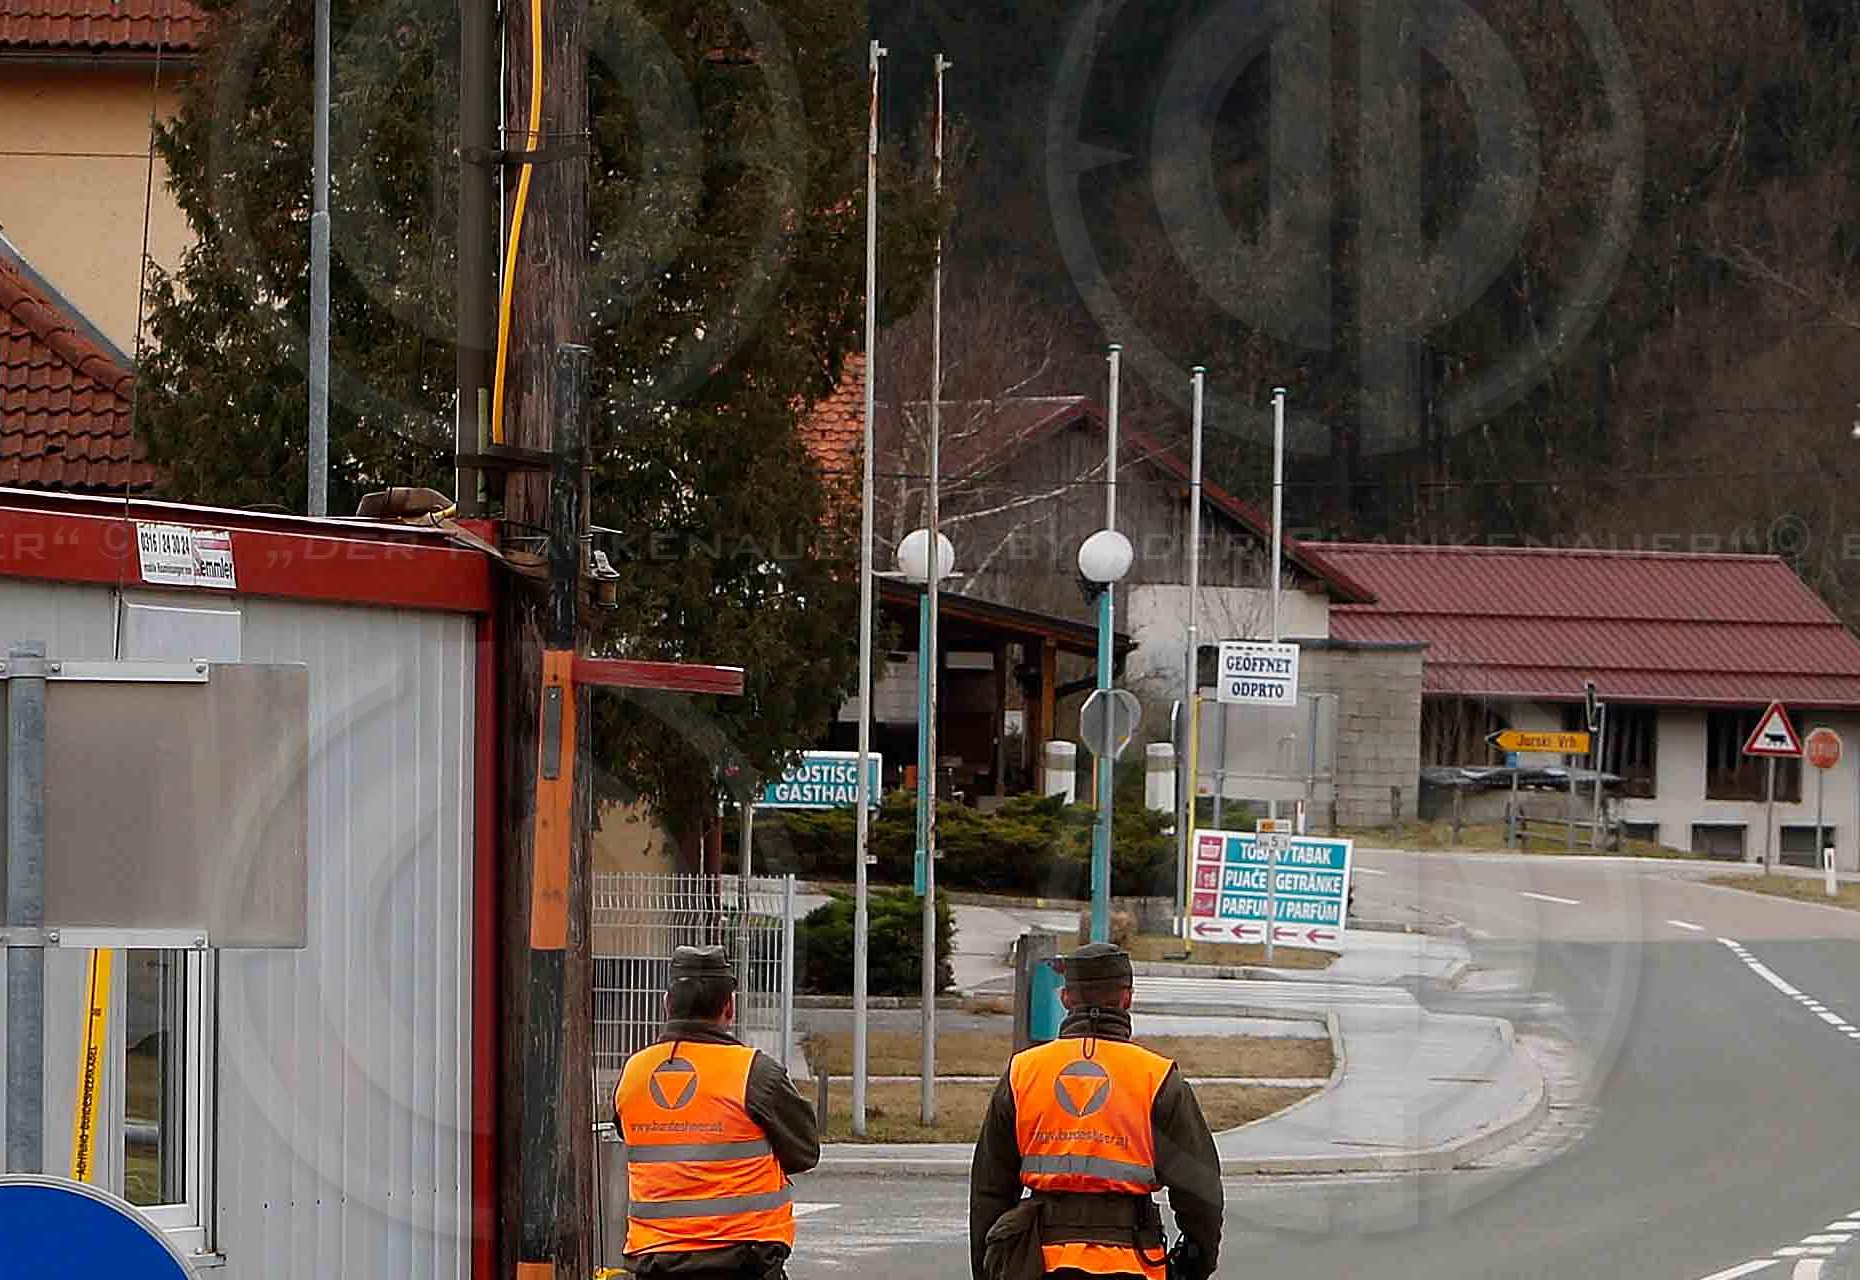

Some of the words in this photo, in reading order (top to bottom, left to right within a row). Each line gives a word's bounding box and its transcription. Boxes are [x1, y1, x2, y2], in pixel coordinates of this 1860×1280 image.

[1226, 652, 1292, 674] GEÖFFNET
[1231, 681, 1285, 698] ODPRTO
[1291, 847, 1333, 865] TABAK
